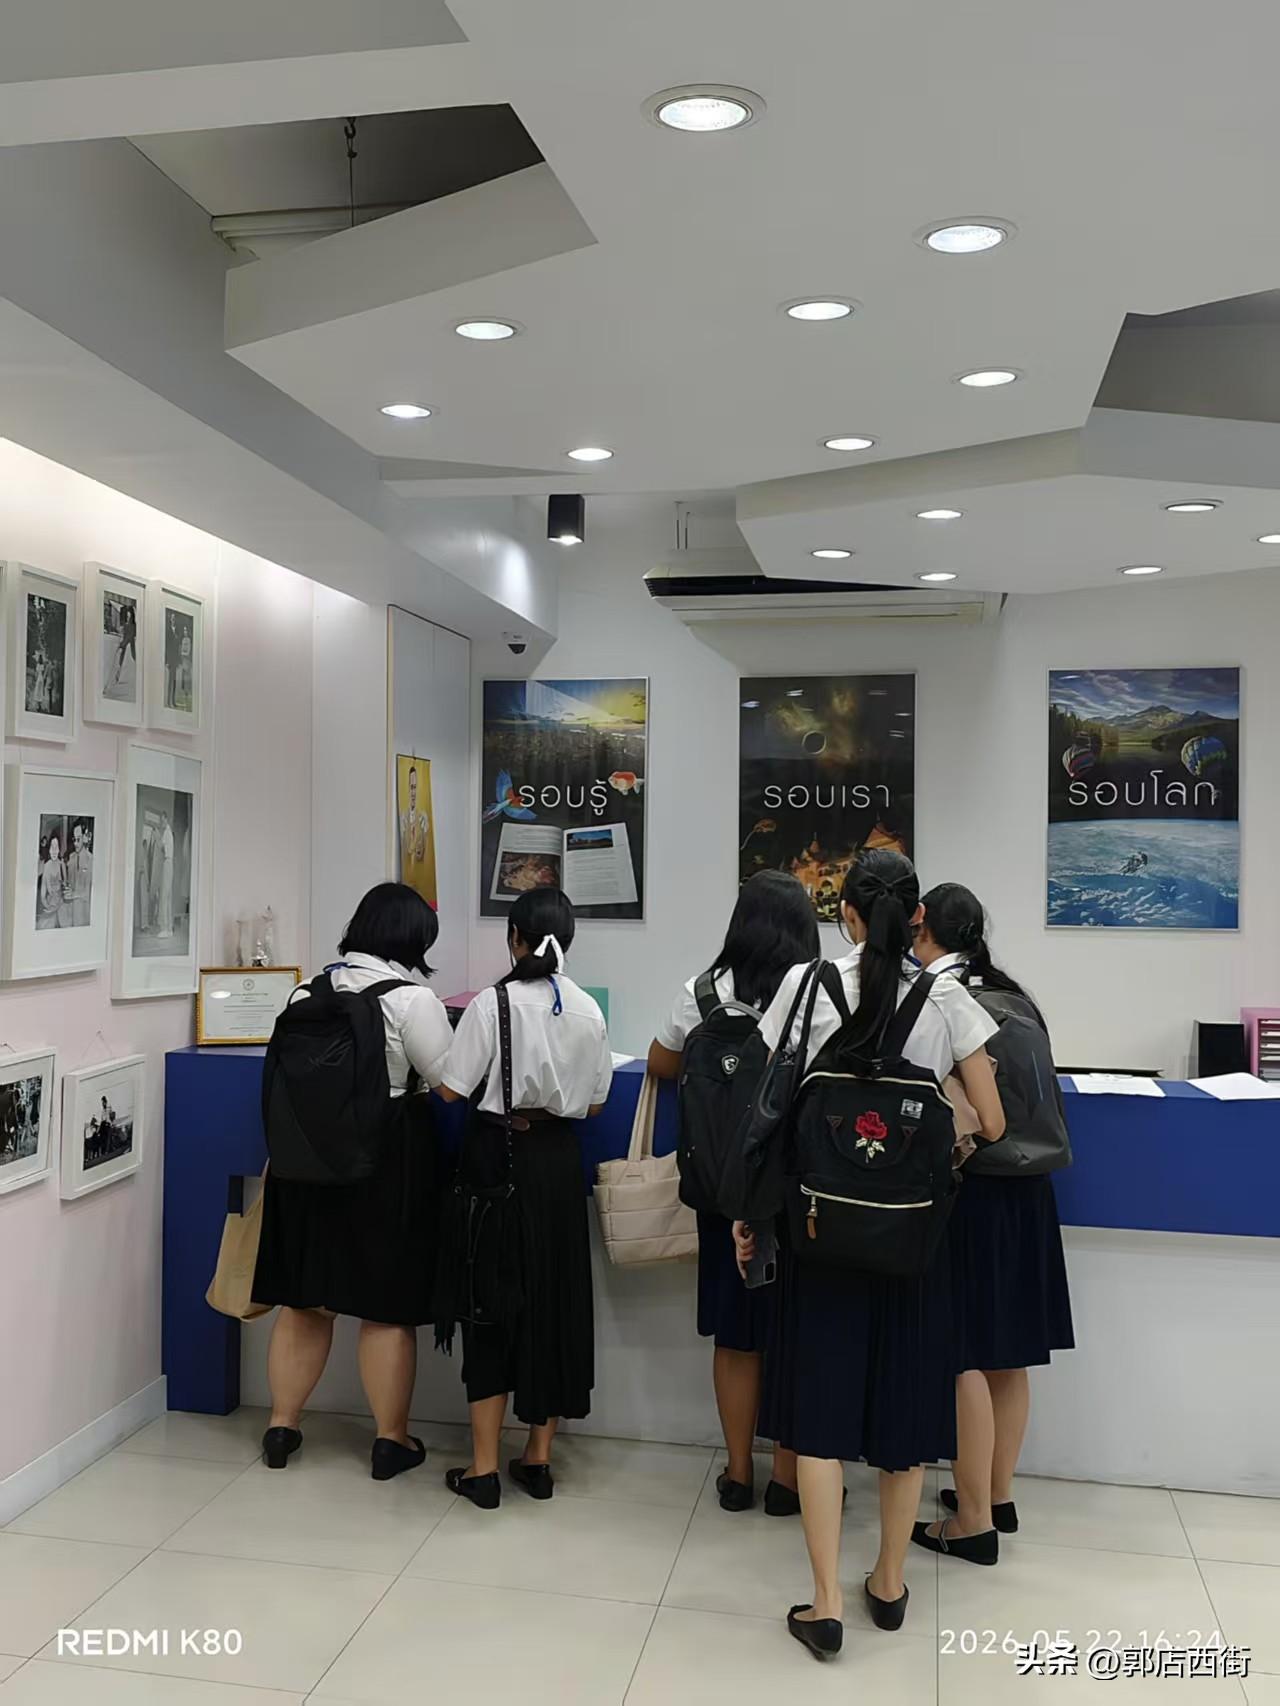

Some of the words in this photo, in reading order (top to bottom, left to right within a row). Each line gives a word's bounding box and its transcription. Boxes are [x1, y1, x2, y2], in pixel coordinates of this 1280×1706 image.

[517, 778, 609, 815] รอบรู้
[763, 783, 891, 809] รอบเรา
[1068, 769, 1216, 806] รอบโลก
